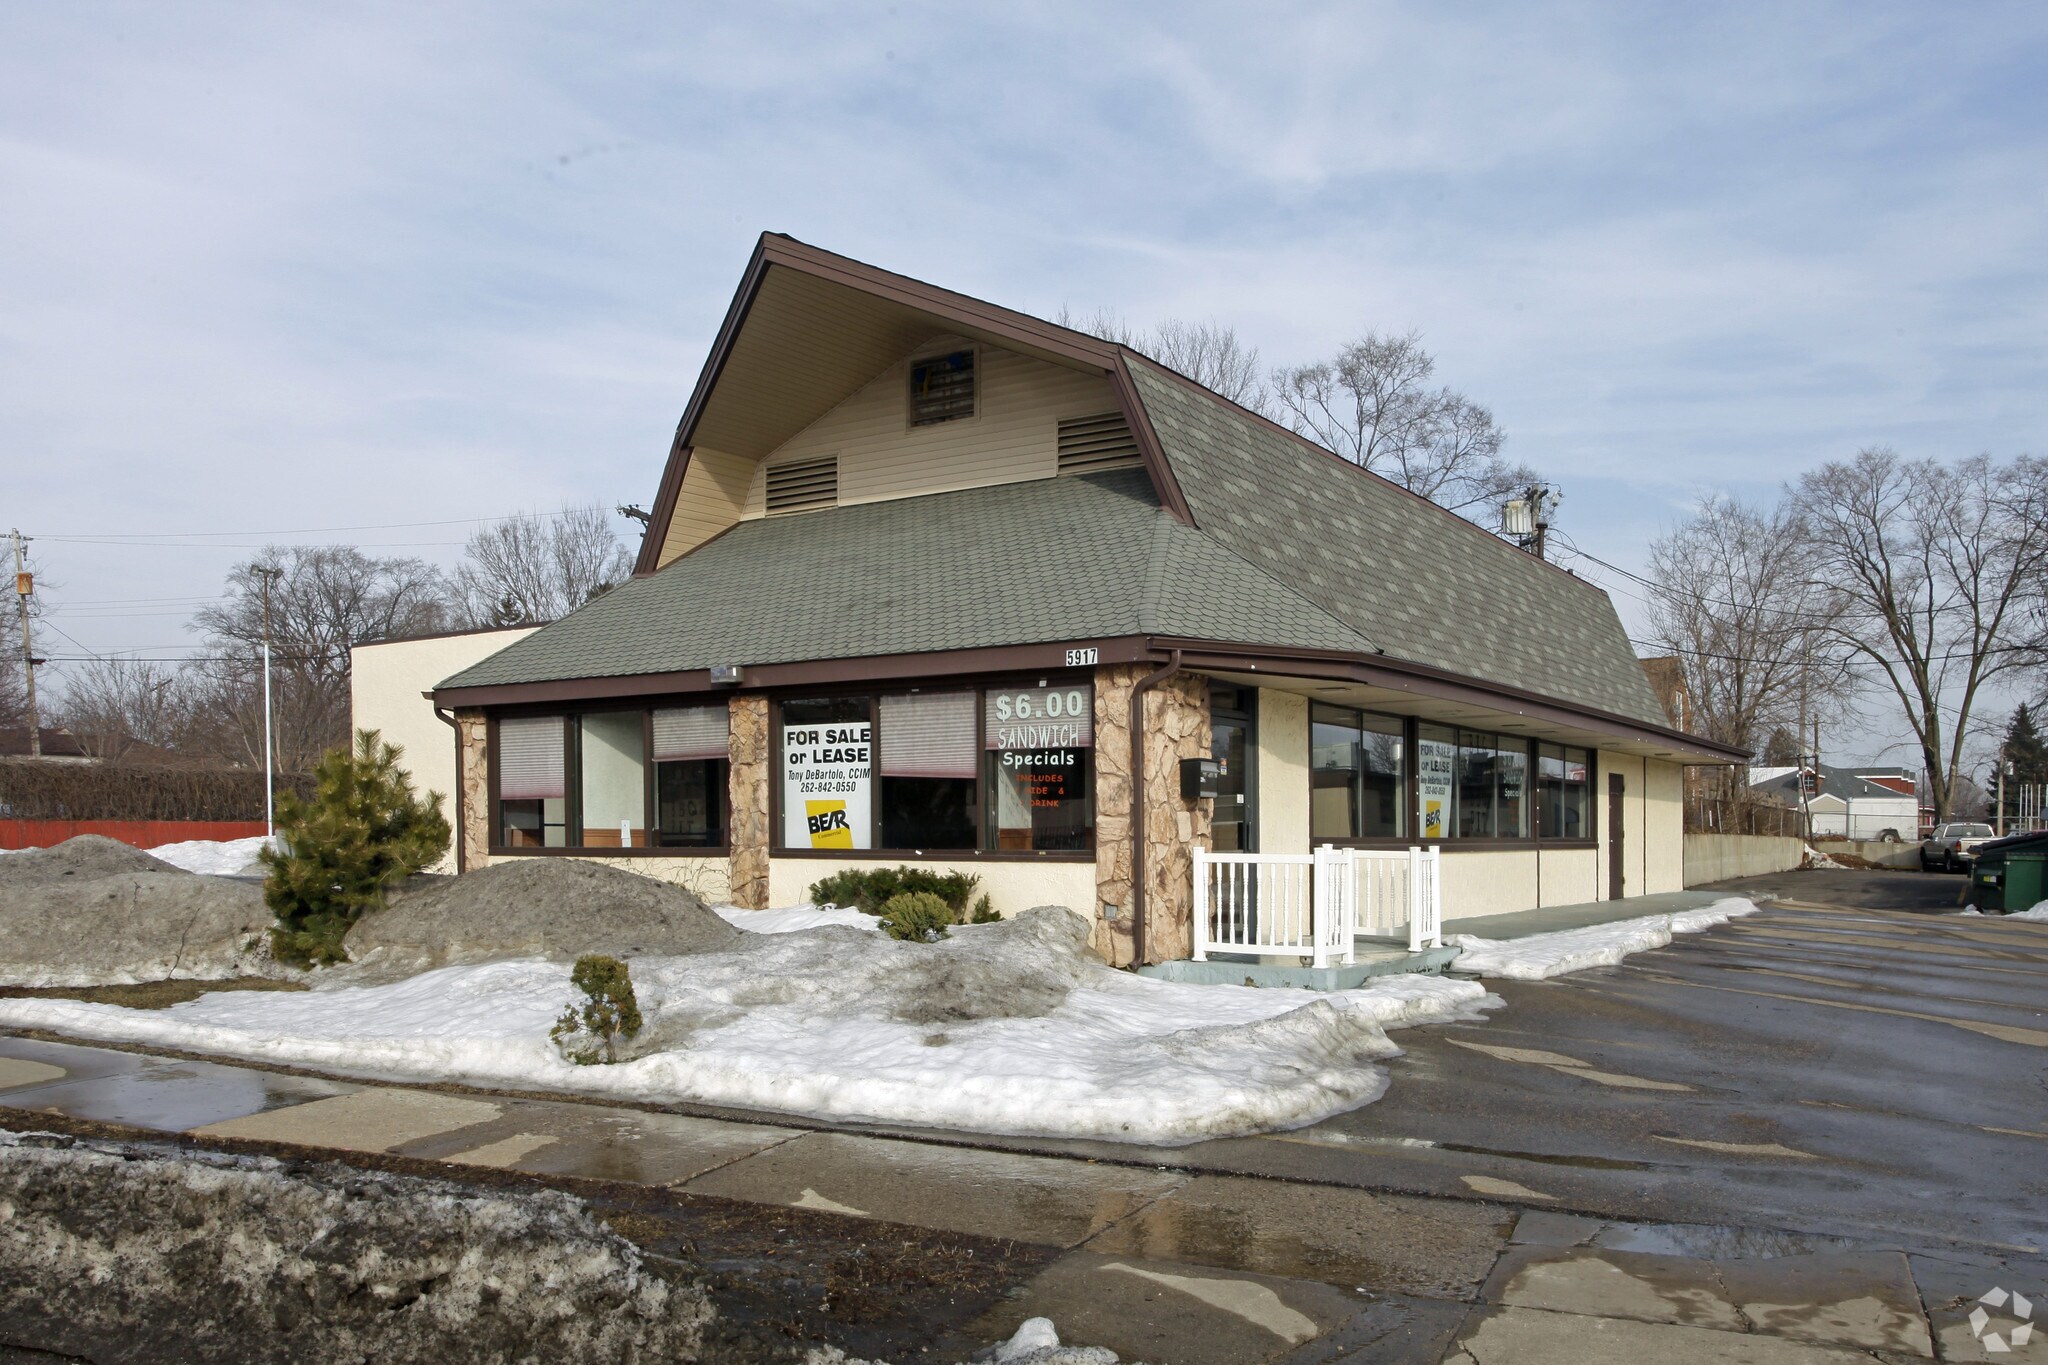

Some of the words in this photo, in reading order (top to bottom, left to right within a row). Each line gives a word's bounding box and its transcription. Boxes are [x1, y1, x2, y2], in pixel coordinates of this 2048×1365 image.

[1067, 648, 1097, 665] 5917
[995, 691, 1083, 722] $6.00
[787, 731, 820, 746] FOR
[825, 728, 871, 745] SALE
[998, 724, 1079, 749] SANDWICH
[789, 752, 807, 765] or
[813, 747, 869, 764] LEASE
[1420, 744, 1434, 757] FOR
[1002, 750, 1075, 769] Specials
[1421, 761, 1429, 771] or
[1430, 760, 1450, 773] LEASE
[788, 770, 804, 782] Tony
[805, 768, 846, 781] DeBartolo,
[848, 768, 871, 779] CCIM
[1015, 774, 1064, 783] INCLUDES
[800, 781, 857, 793] 262-842-0550
[1030, 799, 1060, 808] DRINK
[808, 809, 850, 834] BEAR
